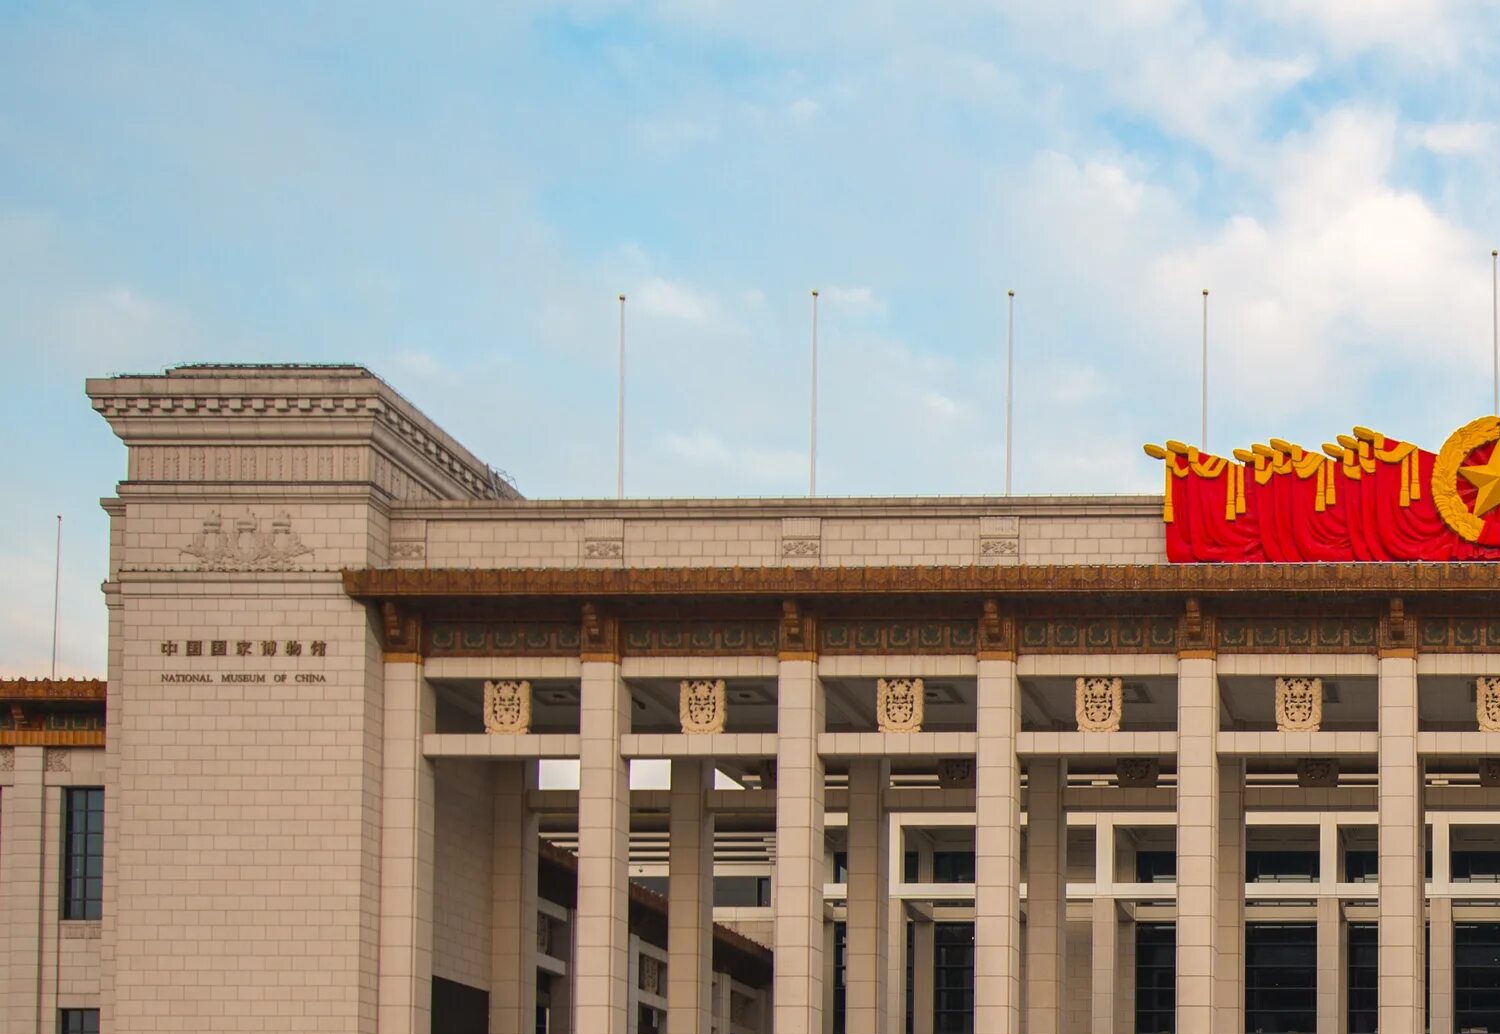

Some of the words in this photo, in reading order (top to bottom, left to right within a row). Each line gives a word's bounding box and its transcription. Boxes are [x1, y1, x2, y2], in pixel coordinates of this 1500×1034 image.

[161, 640, 327, 656] 中国国家博物馆
[161, 674, 213, 682] NATIONAL
[221, 674, 265, 682] MUSEUM
[274, 674, 287, 682] OF
[295, 674, 326, 682] CHINA
